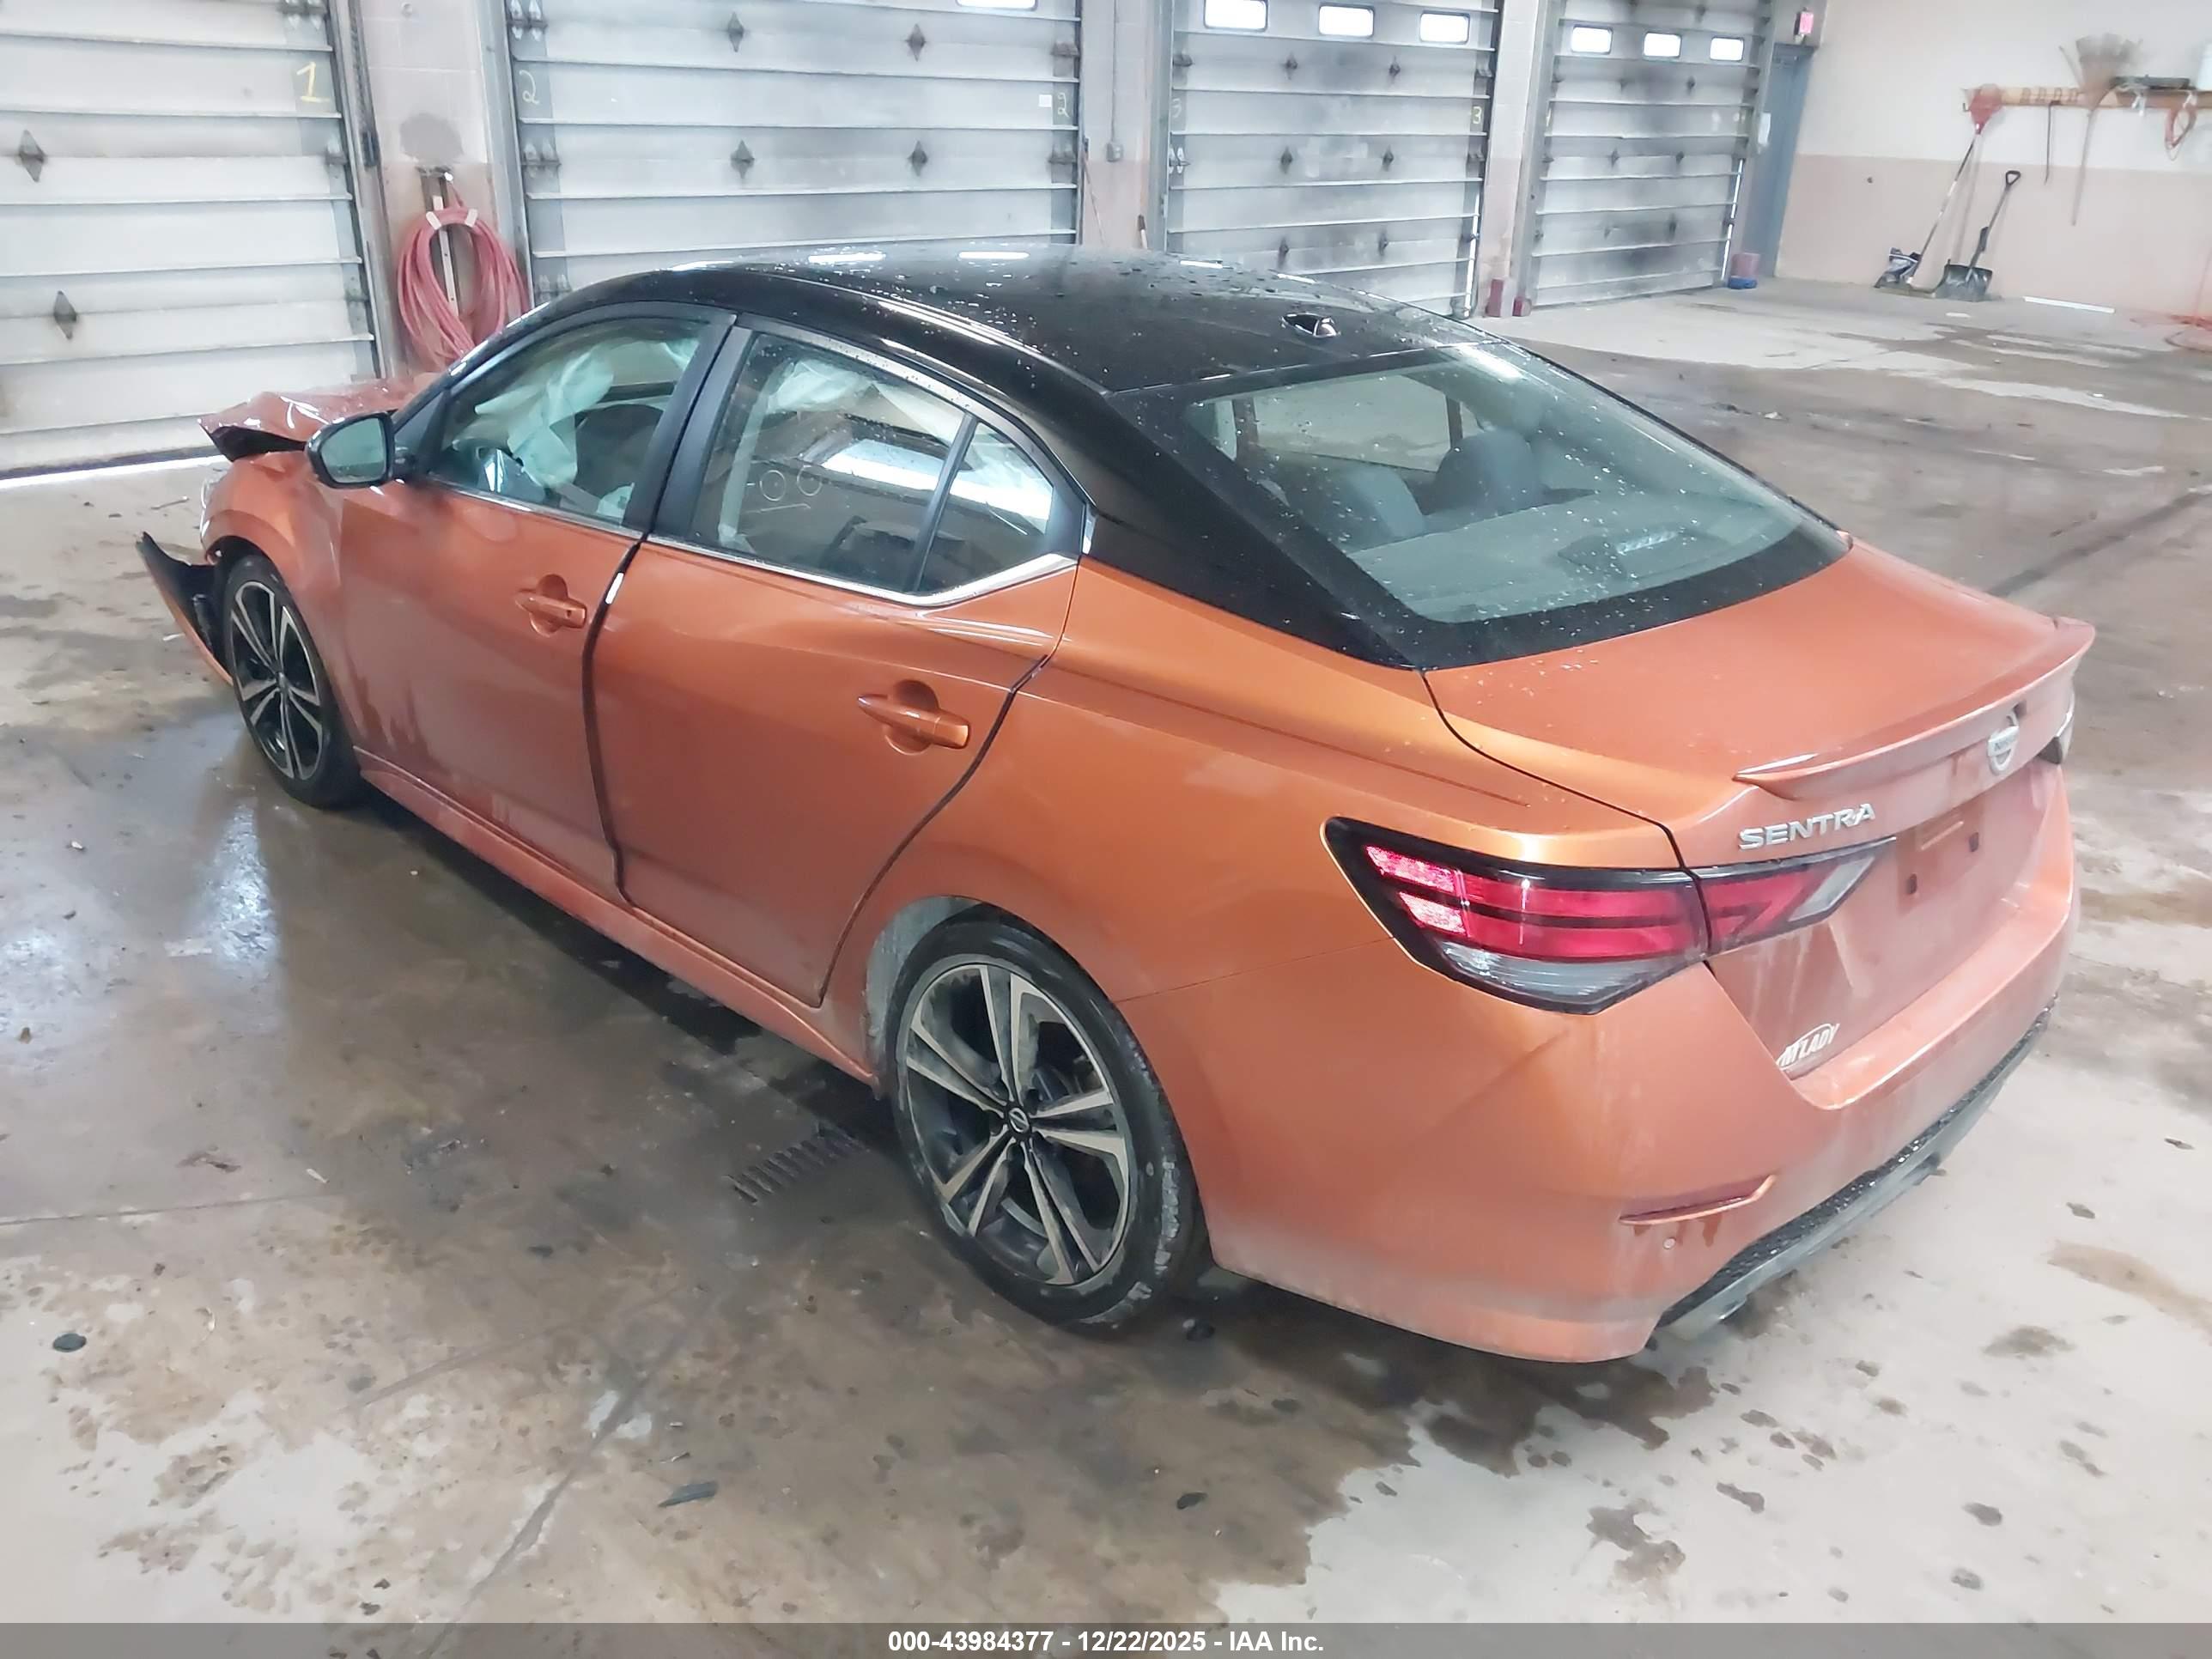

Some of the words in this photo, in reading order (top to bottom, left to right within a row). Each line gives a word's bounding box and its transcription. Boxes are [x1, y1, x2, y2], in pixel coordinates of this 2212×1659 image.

[296, 62, 331, 102] 1
[519, 70, 540, 104] 2
[1473, 106, 1482, 125] 3
[1739, 803, 1876, 851] SENTRA
